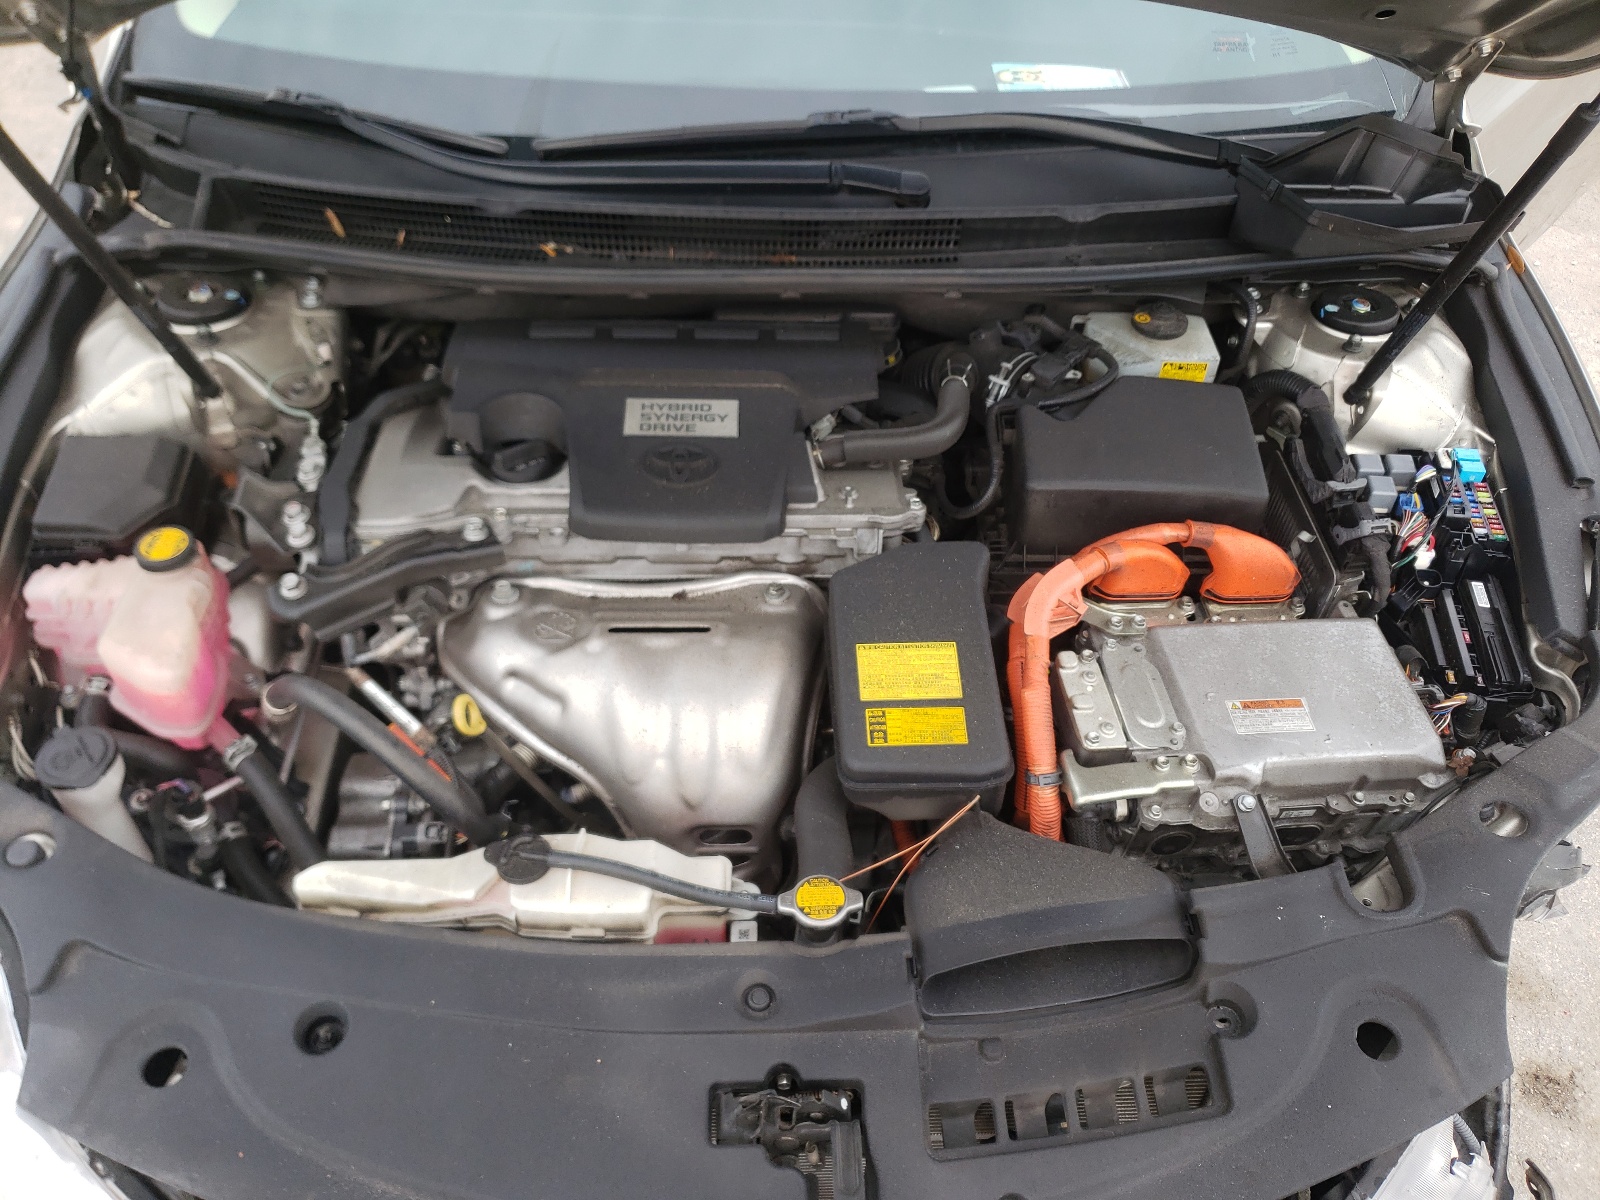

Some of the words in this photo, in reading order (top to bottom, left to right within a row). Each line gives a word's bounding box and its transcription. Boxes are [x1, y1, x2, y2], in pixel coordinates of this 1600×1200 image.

[641, 403, 712, 412] HYBRID
[640, 413, 728, 422] SYNERGY
[639, 422, 697, 432] DRIVE
